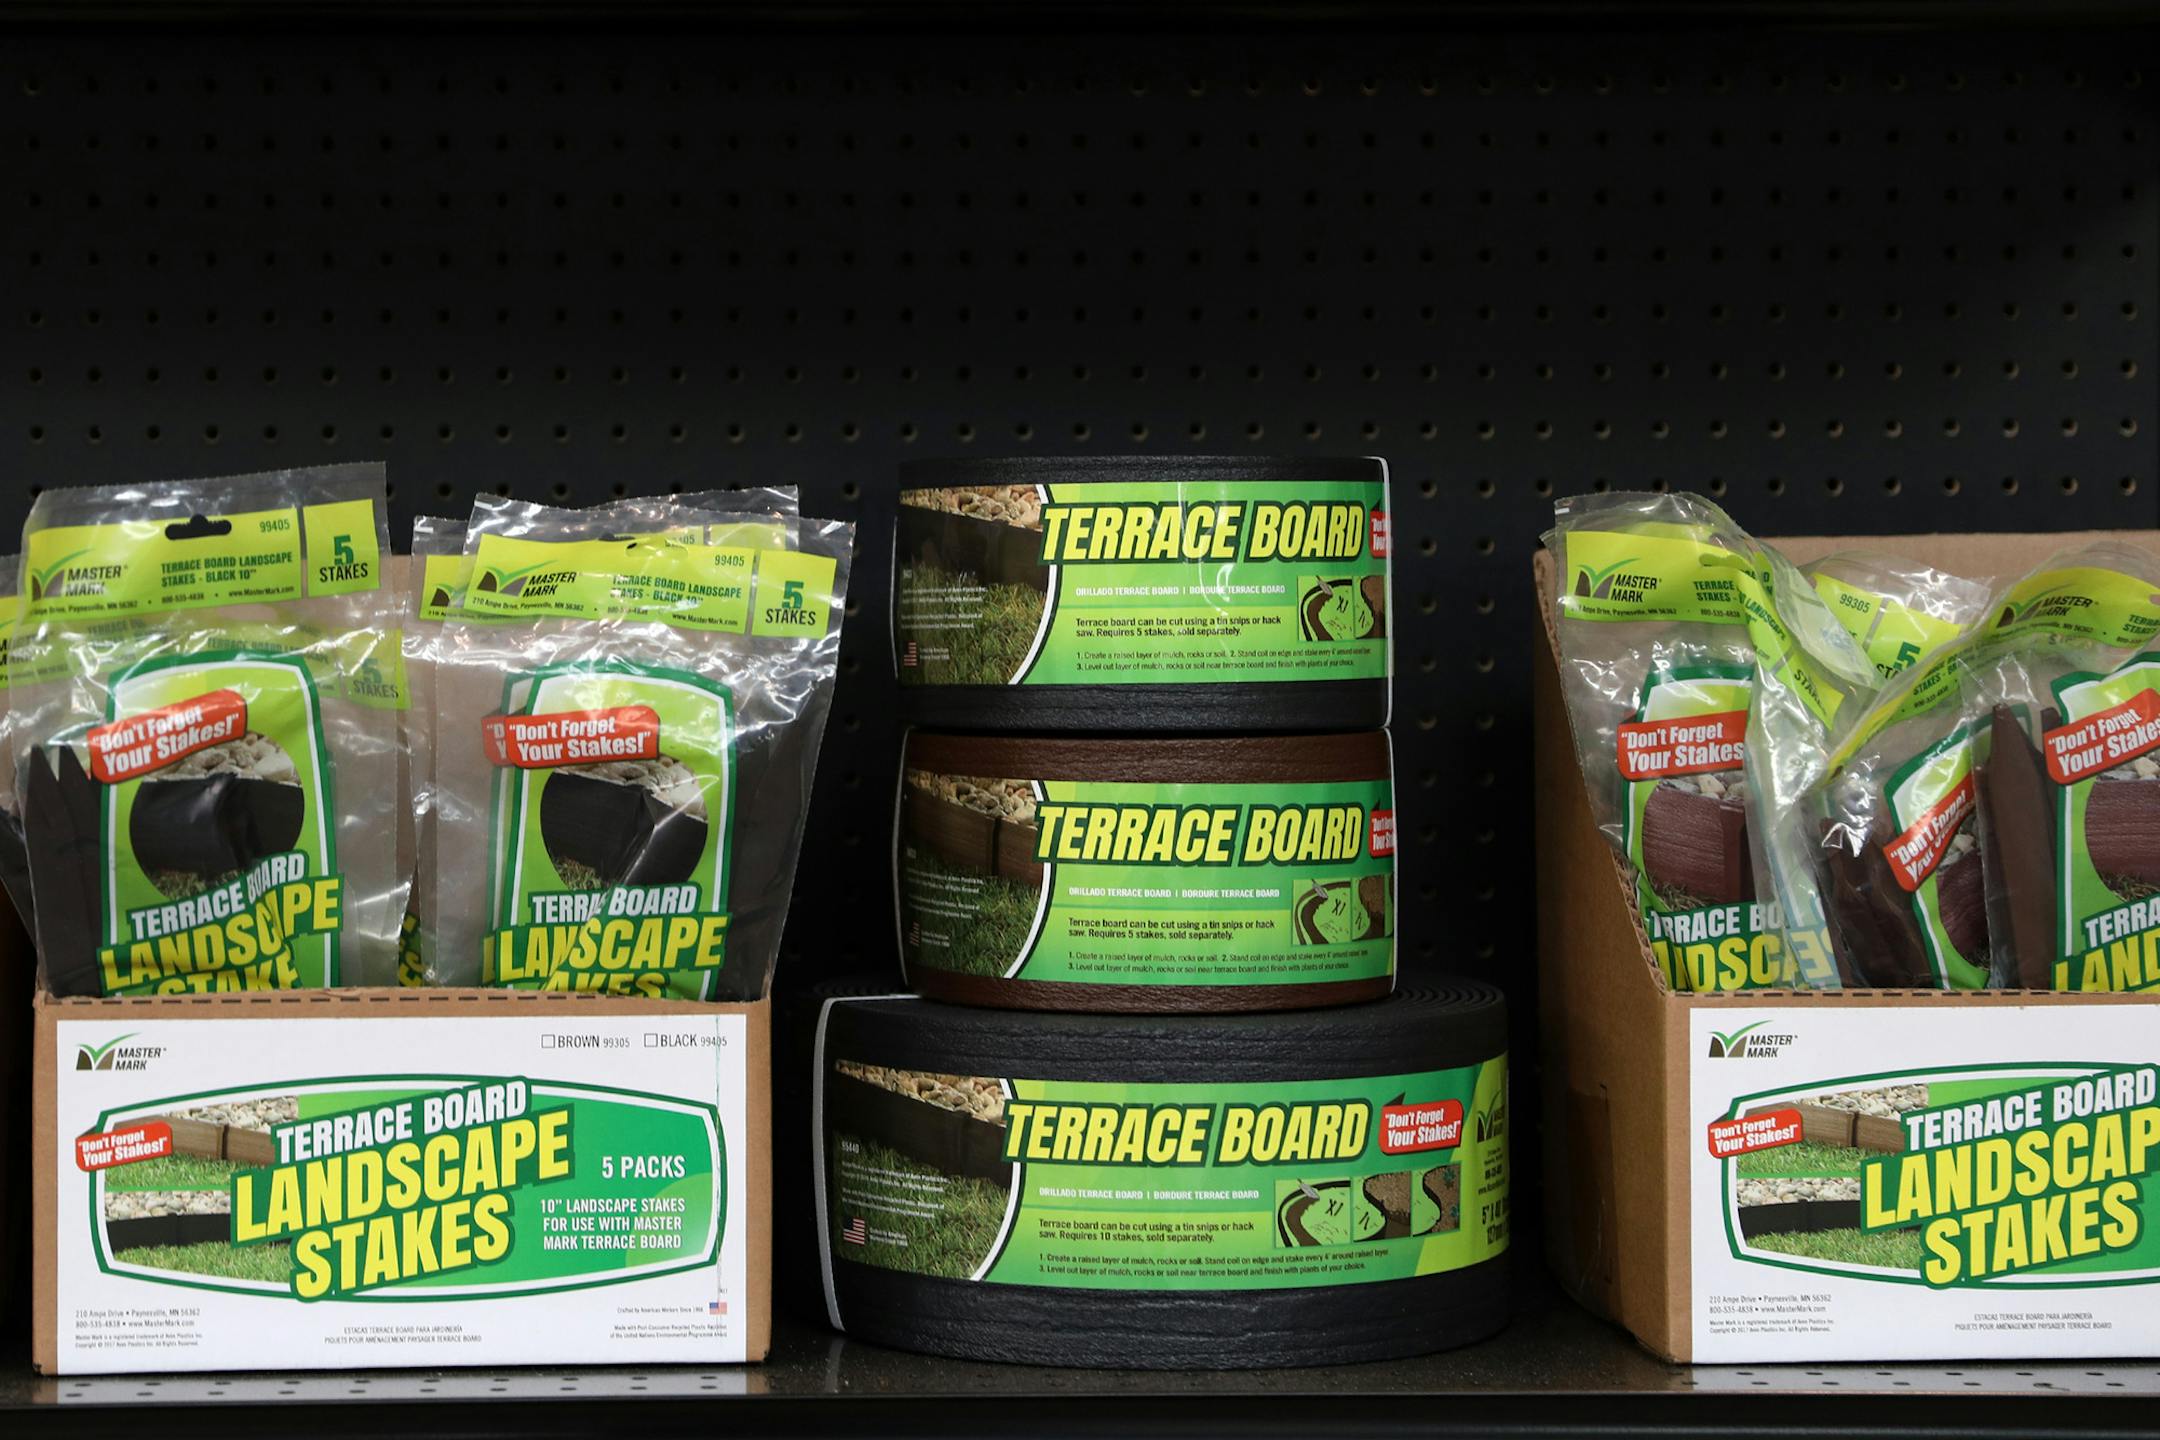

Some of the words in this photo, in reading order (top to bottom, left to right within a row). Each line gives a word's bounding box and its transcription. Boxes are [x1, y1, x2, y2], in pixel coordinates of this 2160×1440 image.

[259, 519, 290, 532] 99405
[1043, 505, 1240, 561] TERRACE
[1250, 503, 1364, 559] BOARD
[334, 534, 353, 564] 5
[162, 562, 201, 574] TERRACE
[204, 557, 236, 569] BOARD
[239, 552, 293, 566] LANDSCAPE
[715, 555, 745, 566] 99405
[68, 565, 122, 581] MASTER
[162, 573, 196, 587] STAKES
[206, 569, 235, 583] BLACK
[319, 563, 368, 583] STAKES
[529, 571, 577, 585] MASTER
[1615, 574, 1657, 589] MASTER
[66, 581, 106, 596] MARK
[523, 586, 556, 598] MARK
[654, 578, 685, 590] BOARD
[688, 583, 742, 598] LANDSCAPE
[1693, 581, 1734, 590] TERRACE
[782, 580, 804, 609] 5
[1611, 589, 1643, 602] MARK
[1696, 592, 1730, 601] STAKES
[1839, 593, 1870, 613] 99305
[673, 613, 738, 626] www.MasterMark.com
[765, 608, 816, 625] STAKES
[1077, 618, 1108, 627] Terrace
[1111, 618, 1135, 626] board
[1156, 618, 1167, 626] be
[1185, 618, 1207, 627] using
[1217, 617, 1227, 625] tin
[1230, 616, 1250, 626] snips
[1263, 616, 1281, 624] hack
[1077, 629, 1094, 637] saw.
[1097, 628, 1134, 638] Requires
[1145, 628, 1175, 637] stakes,
[1178, 628, 1194, 636] sold
[1197, 627, 1242, 637] separately.
[1892, 642, 1920, 672] 5
[147, 705, 203, 734] Forget
[561, 716, 615, 738] Forget
[2098, 709, 2141, 737] Forget
[1670, 722, 1723, 743] Forget
[517, 742, 563, 761] Your
[102, 745, 152, 776] Your
[1628, 749, 1671, 772] Your
[2058, 745, 2103, 776] Your
[1038, 807, 1236, 862] TERRACE
[1245, 807, 1362, 861] BOARD
[131, 882, 245, 940] TERRACE
[246, 853, 305, 905] BOARD
[608, 886, 698, 916] BOARD
[1069, 887, 1105, 896] ORILLADO
[1108, 888, 1142, 897] TERRACE
[1145, 889, 1171, 897] BOARD
[1182, 890, 1218, 898] BORDURE
[1256, 889, 1279, 897] BOARD
[557, 1035, 600, 1048] BROWN
[603, 1038, 631, 1047] 99305
[660, 1033, 697, 1047] BLACK
[700, 1037, 727, 1047] 99405
[1750, 1035, 1792, 1045] MASTER
[117, 1047, 161, 1058] MASTER
[1747, 1048, 1778, 1057] MARK
[115, 1060, 147, 1070] MARK
[1416, 1108, 1444, 1125] Forget
[1906, 1090, 2043, 1151] TERRACE
[2052, 1067, 2156, 1122] BOARD
[277, 1103, 412, 1163] TERRACE
[424, 1081, 526, 1134] BOARD
[1743, 1118, 1776, 1134] Forget
[110, 1129, 145, 1145] Forget
[1007, 1104, 1211, 1163] TERRACE
[1219, 1102, 1370, 1161] BOARD
[1388, 1130, 1416, 1147] Your
[1715, 1139, 1744, 1153] Your
[82, 1150, 113, 1167] Your
[602, 1157, 614, 1178] 5
[621, 1155, 685, 1178] PACKS
[236, 1111, 569, 1242] LANDSCAPE
[1040, 1187, 1076, 1197] ORILLADO
[1078, 1189, 1113, 1198] TERRACE
[1116, 1190, 1143, 1199] BOARD
[1154, 1191, 1192, 1199] BORDURE
[1195, 1190, 1230, 1200] TERRACE
[1232, 1190, 1259, 1198] BOARD
[566, 1198, 637, 1212] LANDSCAPE
[641, 1198, 685, 1212] STAKES
[544, 1217, 567, 1231] FOR
[572, 1217, 594, 1231] USE
[599, 1217, 630, 1231] WITH
[634, 1216, 682, 1230] MASTER
[1040, 1219, 1071, 1229] Terrace
[1074, 1221, 1098, 1230] board
[1120, 1222, 1130, 1230] be
[1133, 1223, 1147, 1231] cut
[1150, 1223, 1172, 1232] using
[1183, 1223, 1194, 1231] tin
[1196, 1223, 1218, 1232] snips
[1233, 1222, 1254, 1230] hack
[1060, 1231, 1097, 1241] Requires
[1113, 1233, 1144, 1242] stakes,
[1146, 1233, 1165, 1241] sold
[1167, 1233, 1214, 1243] separately.
[1926, 1182, 2139, 1284] STAKES
[296, 1194, 509, 1298] STAKES
[544, 1235, 578, 1250] MARK
[581, 1235, 636, 1249] TERRACE
[640, 1235, 681, 1248] BOARD
